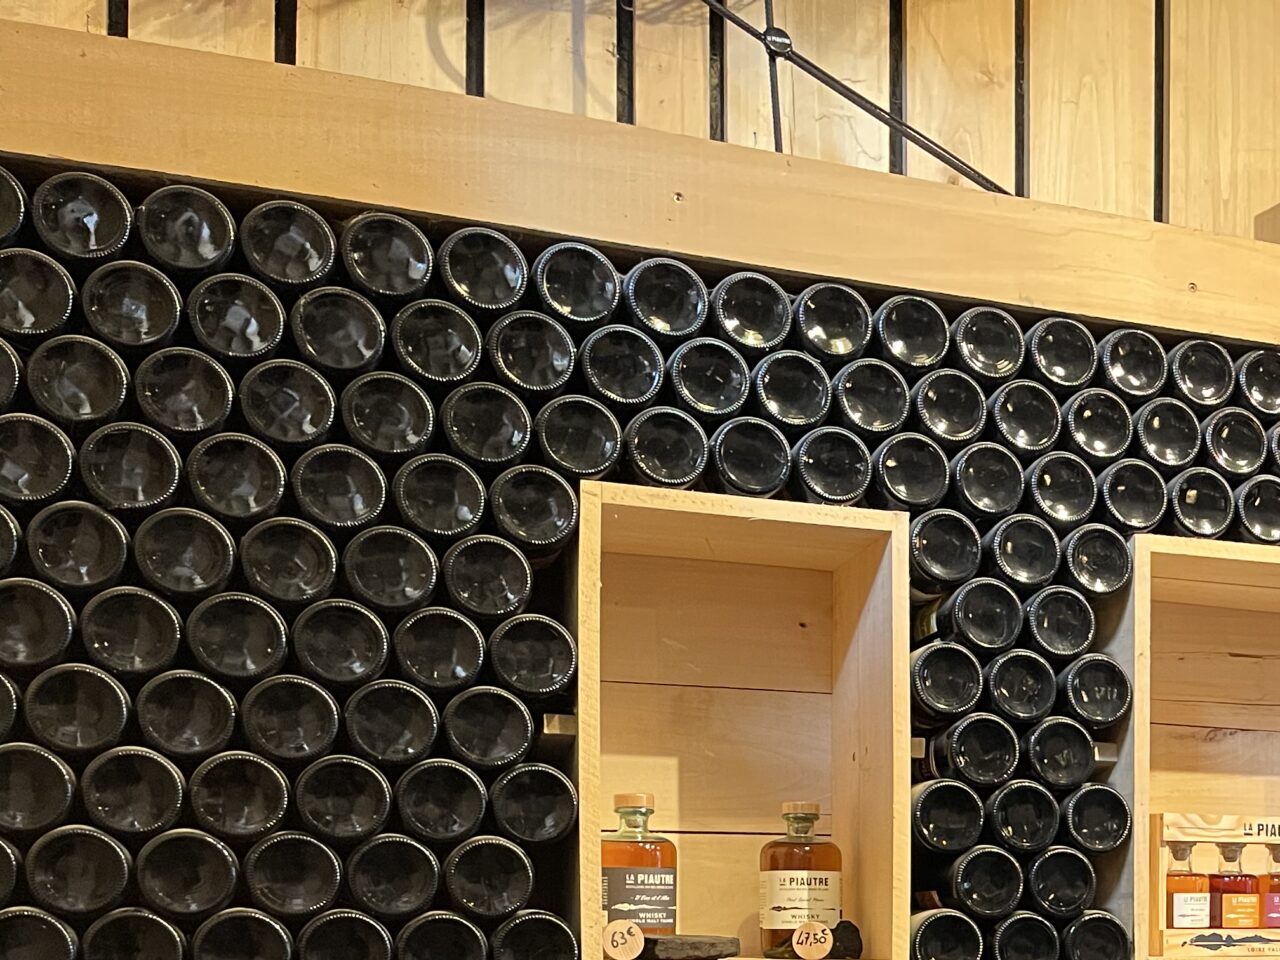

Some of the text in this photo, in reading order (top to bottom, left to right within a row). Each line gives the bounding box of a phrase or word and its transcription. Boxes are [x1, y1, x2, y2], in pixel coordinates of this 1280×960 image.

[1244, 823, 1253, 835] LA
[626, 874, 674, 884] LA PIAUTRE
[789, 877, 829, 886] PIAUTRE
